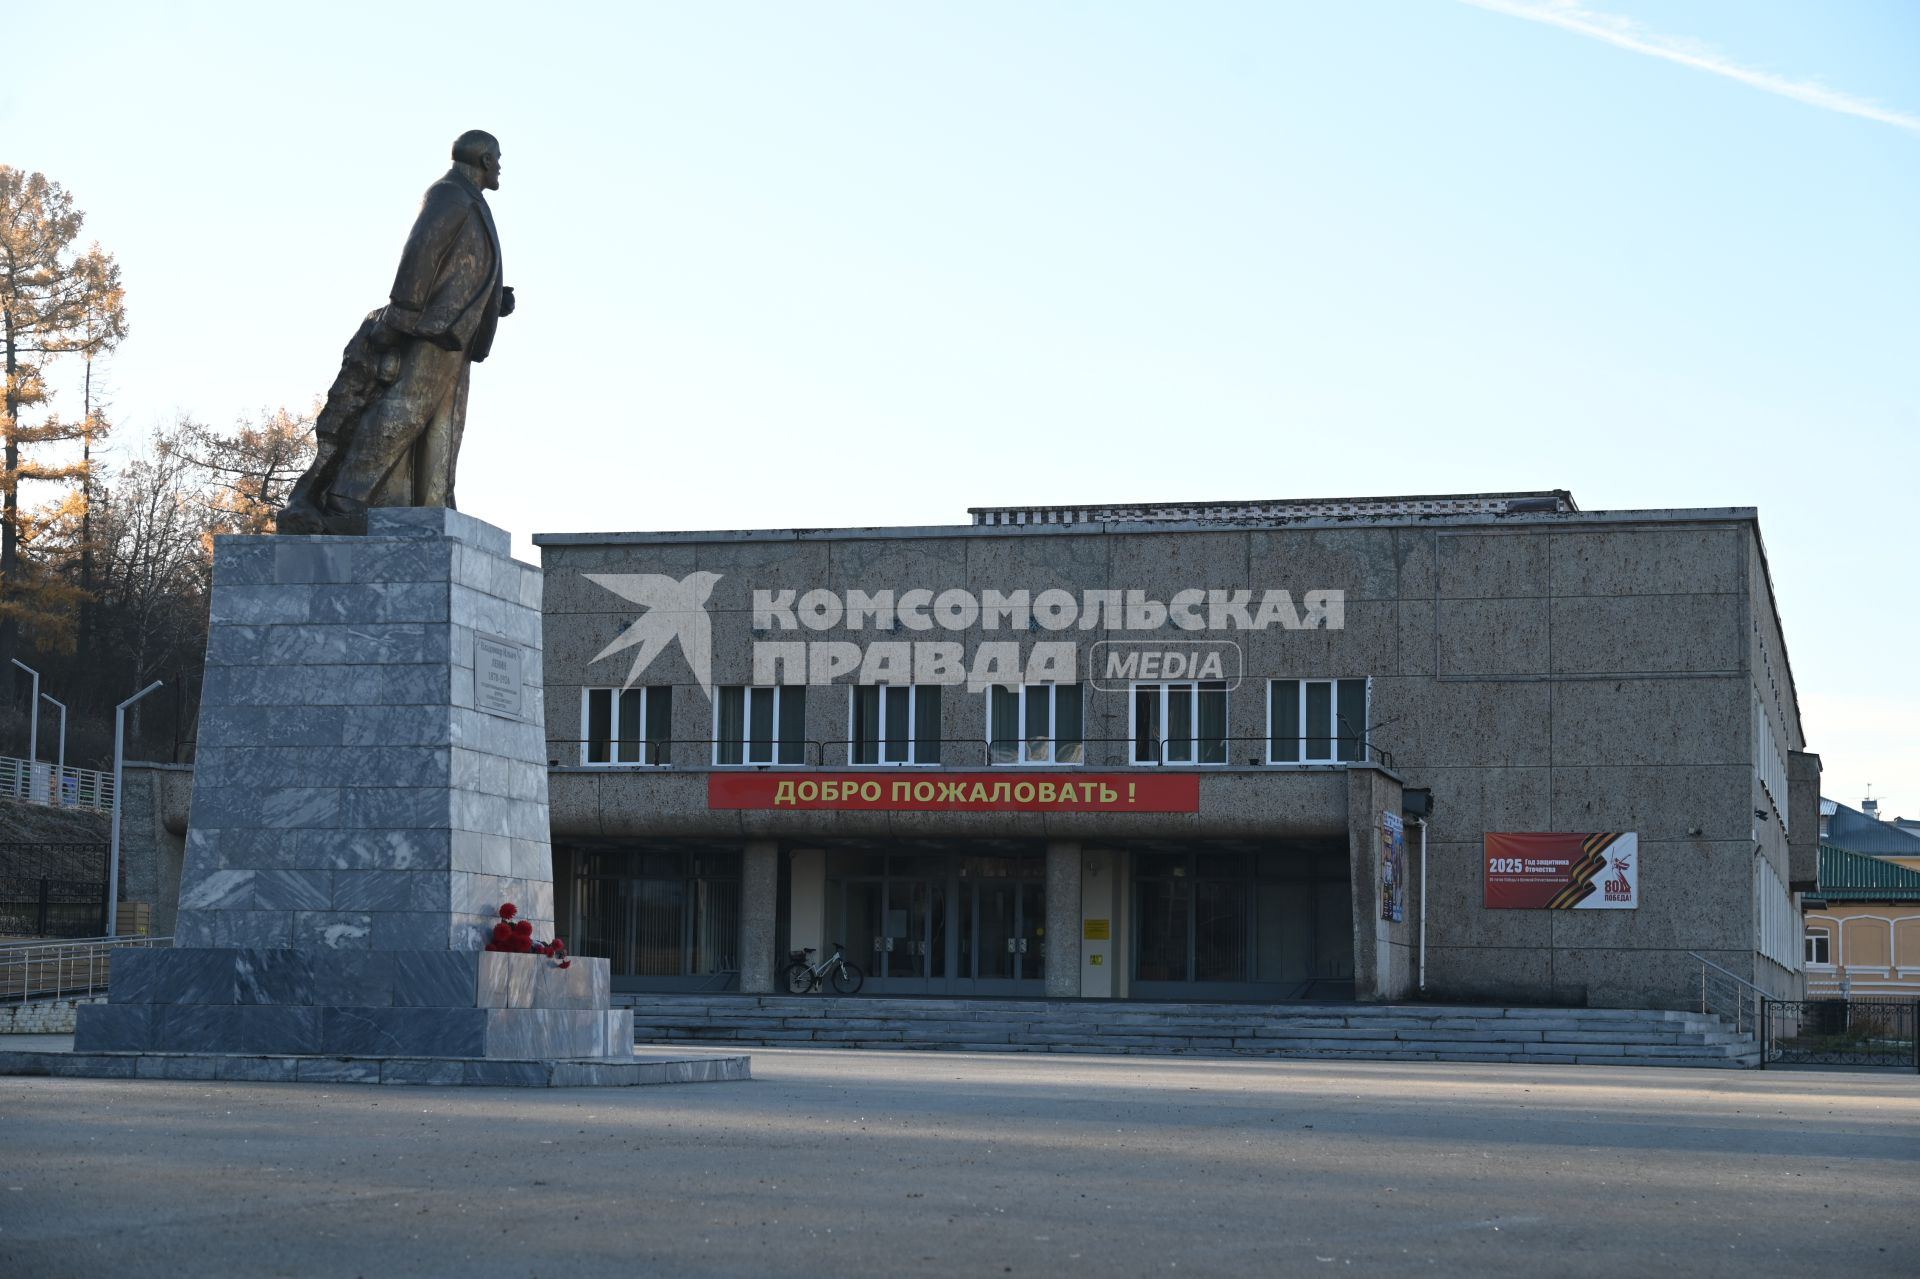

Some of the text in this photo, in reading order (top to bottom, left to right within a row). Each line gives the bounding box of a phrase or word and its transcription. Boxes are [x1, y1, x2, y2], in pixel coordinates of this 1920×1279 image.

[774, 780, 882, 805] ДОБРО
[892, 781, 1118, 803] ПОЖАЛОВАТЬ
[1489, 858, 1523, 873] 2025
[1525, 858, 1536, 866] Год
[1604, 880, 1619, 893] 80
[1604, 894, 1632, 902] ПОБЕДА!
